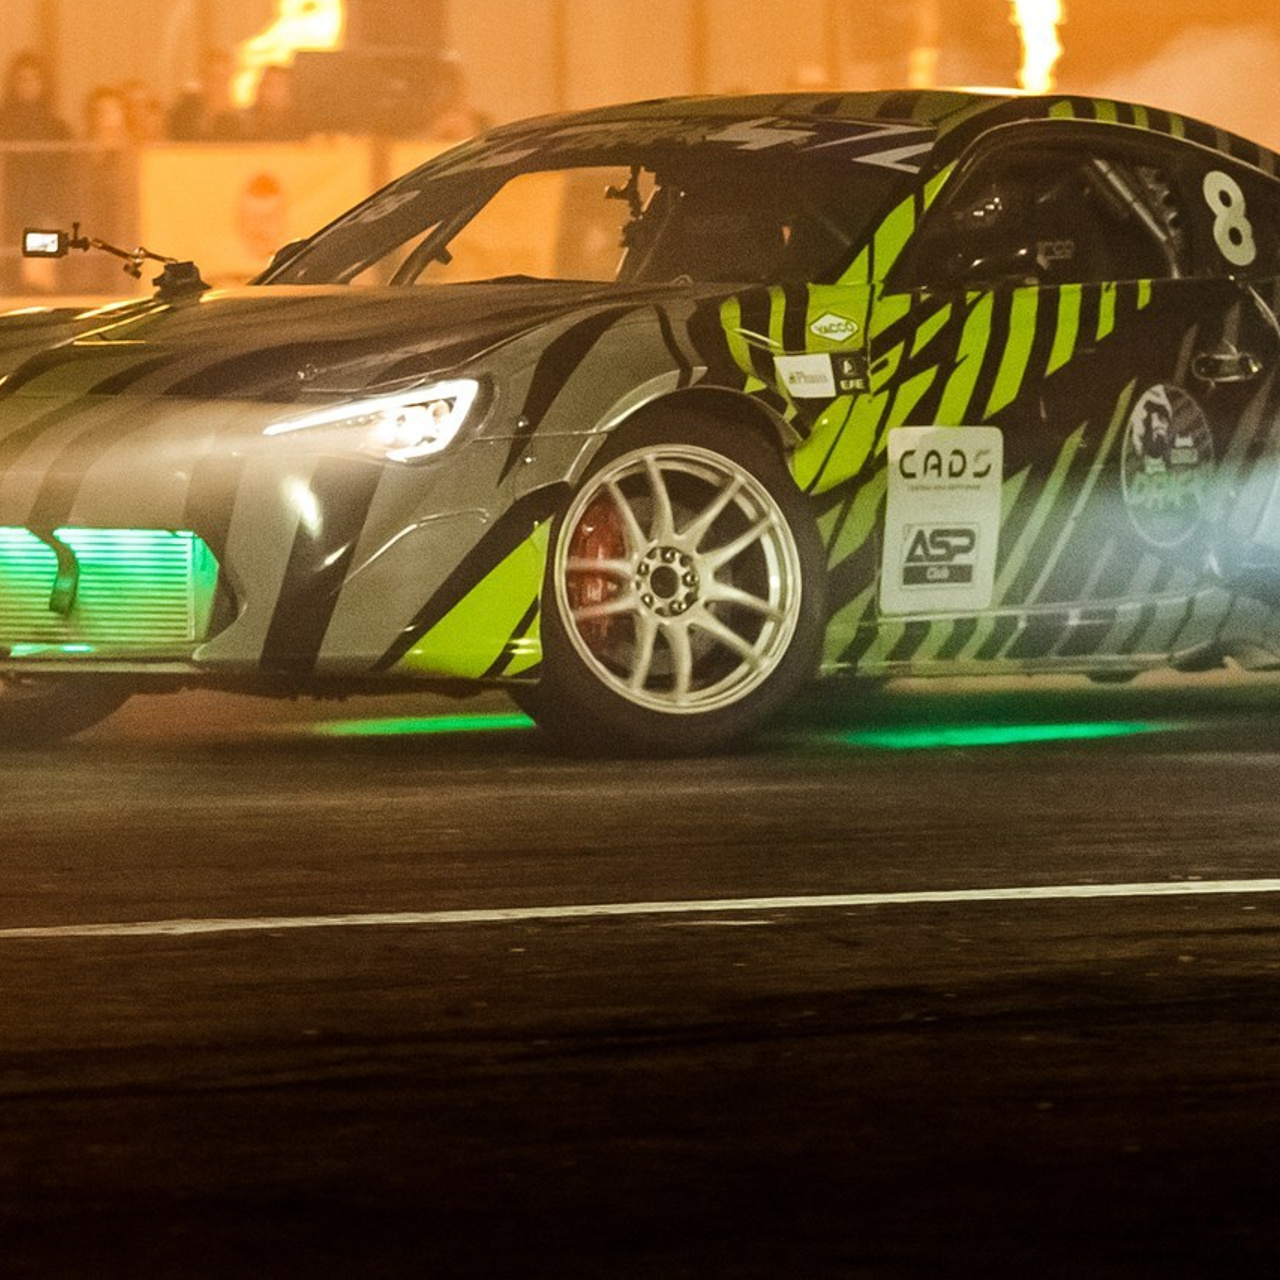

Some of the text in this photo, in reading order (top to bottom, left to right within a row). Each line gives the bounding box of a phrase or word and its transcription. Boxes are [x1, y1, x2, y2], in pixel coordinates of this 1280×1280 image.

[1204, 170, 1256, 267] 8
[899, 449, 992, 479] CADS
[905, 528, 976, 563] ASP
